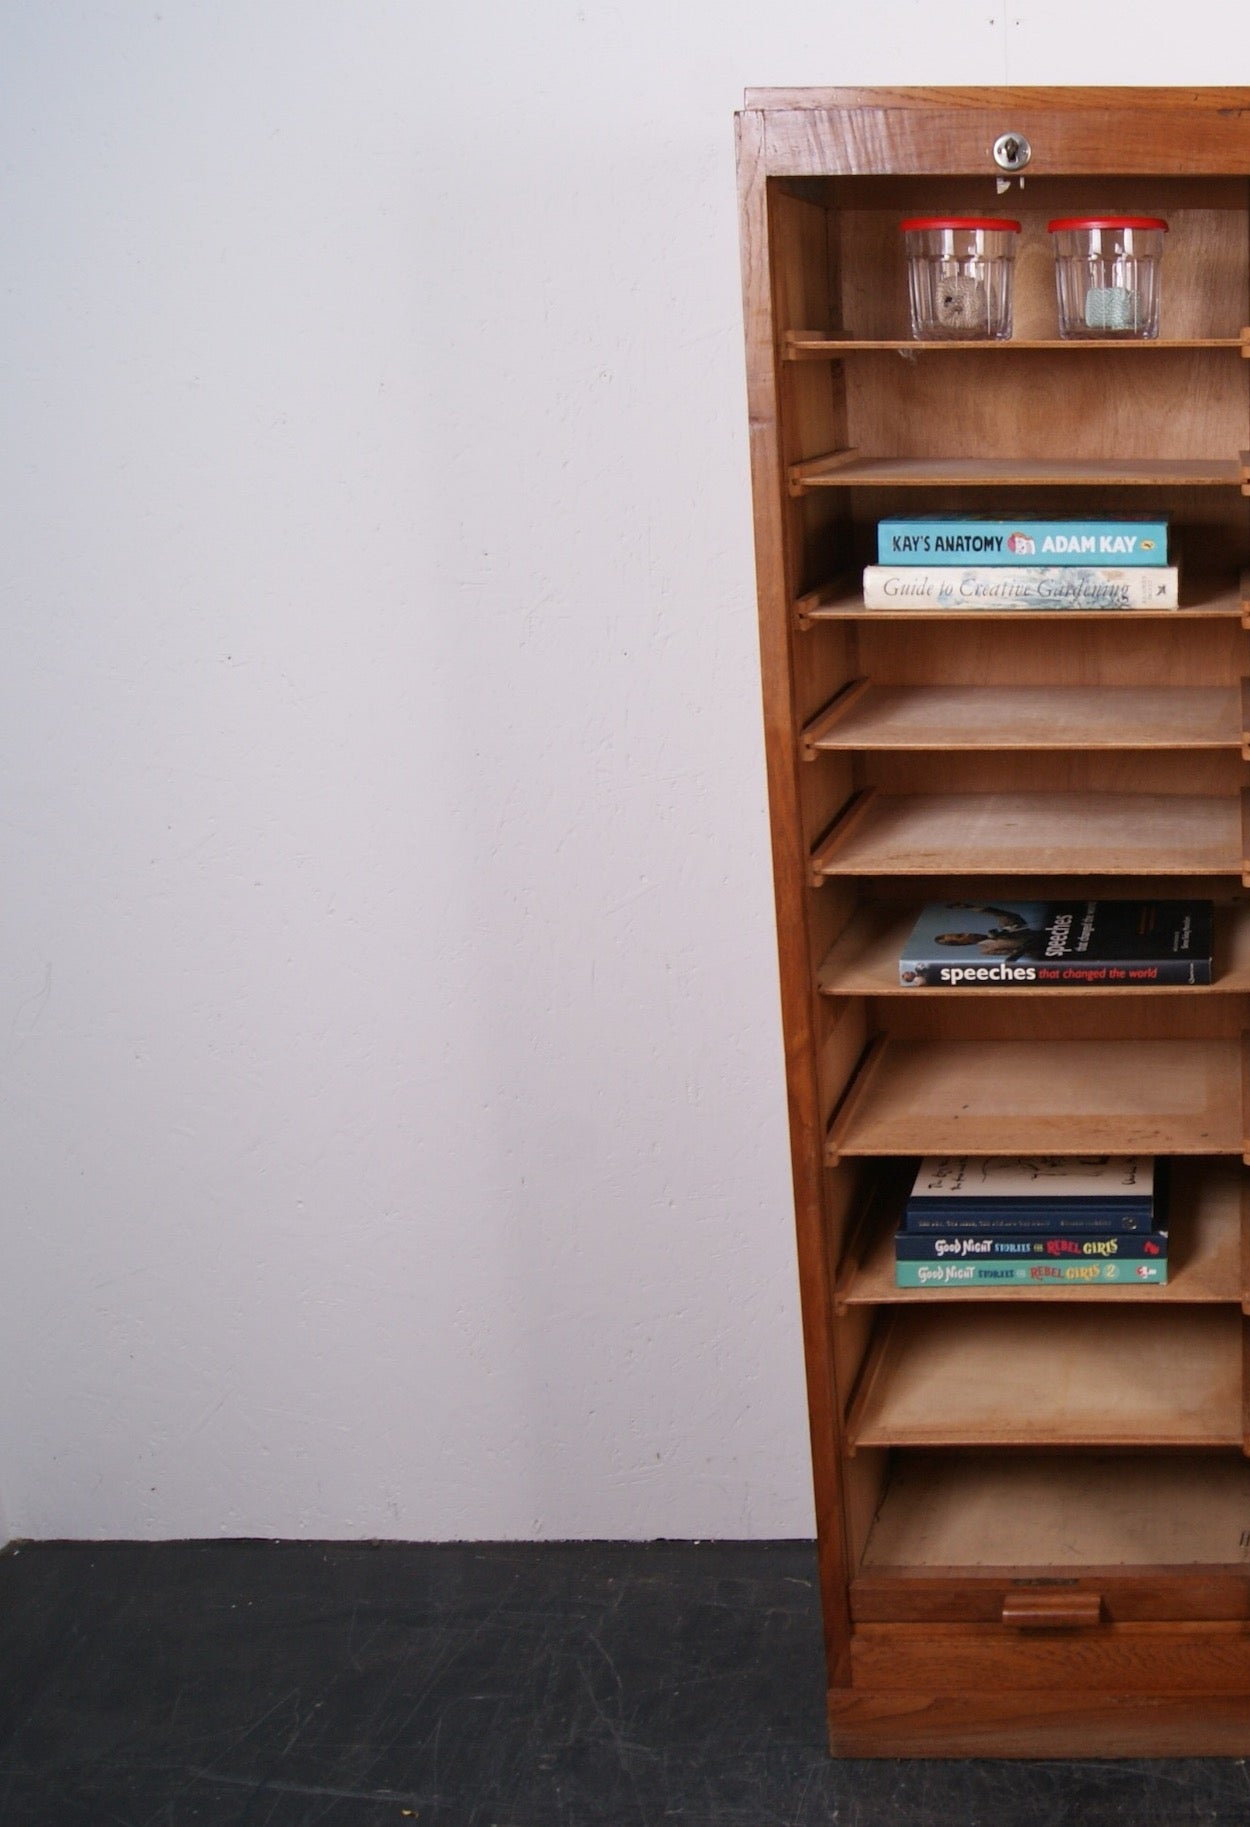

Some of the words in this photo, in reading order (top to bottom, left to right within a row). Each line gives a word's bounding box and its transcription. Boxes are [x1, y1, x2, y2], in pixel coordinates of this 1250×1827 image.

[892, 535, 930, 552] KAY'S
[935, 535, 1003, 552] ANATOMY
[1041, 536, 1095, 553] ADAM
[1100, 536, 1137, 553] KAY
[883, 577, 935, 597] Guide
[938, 577, 953, 599] to
[959, 576, 1033, 597] Creative
[1036, 576, 1130, 604] Gardening
[1045, 914, 1073, 957] speeches
[940, 964, 1036, 984] speeches
[1039, 969, 1060, 979] that
[1062, 968, 1106, 982] changed
[1109, 968, 1126, 979] the
[1129, 967, 1157, 979] world
[995, 1243, 1031, 1252] STORIES
[1046, 1240, 1082, 1256] REBEL
[1082, 1238, 1118, 1256] GIRLS
[978, 1269, 1014, 1278] STORIES
[1030, 1266, 1064, 1281] REBEL
[1065, 1264, 1100, 1281] GIRLS
[1105, 1264, 1115, 1278] 2
